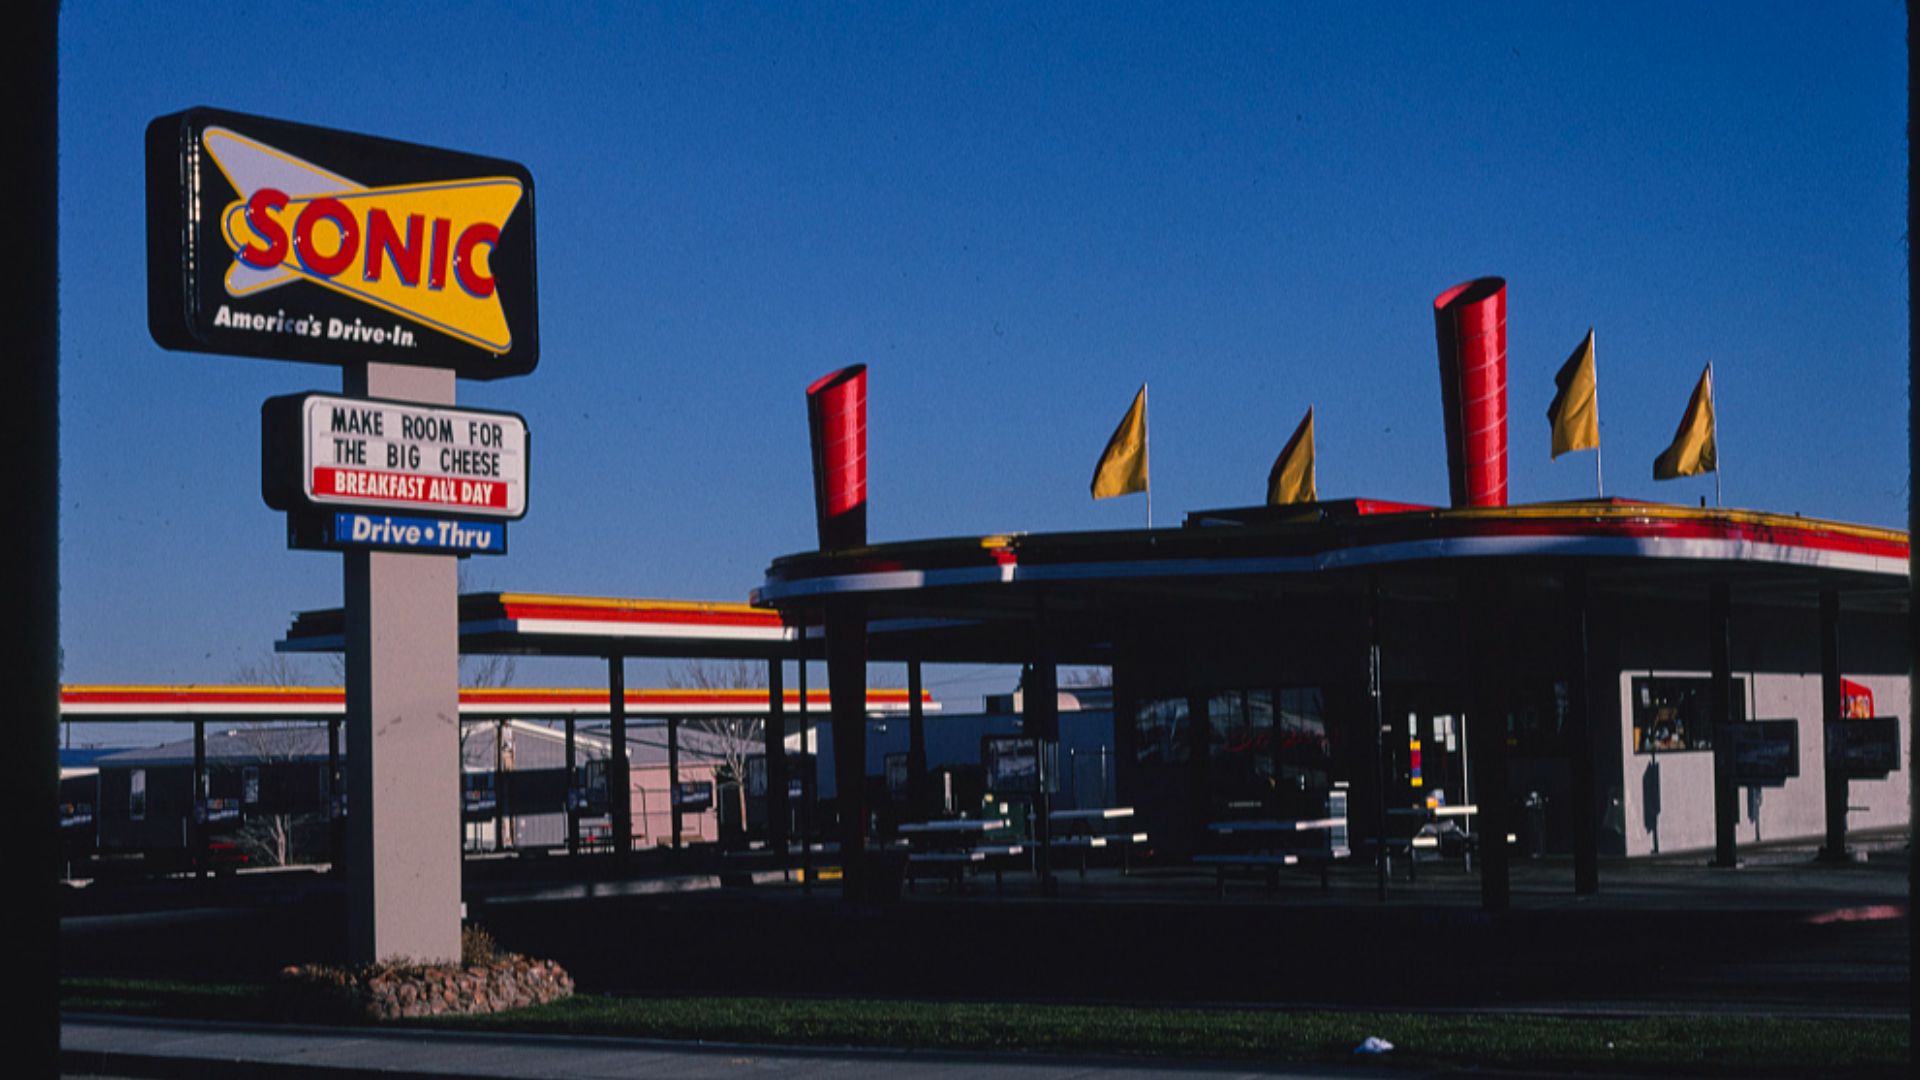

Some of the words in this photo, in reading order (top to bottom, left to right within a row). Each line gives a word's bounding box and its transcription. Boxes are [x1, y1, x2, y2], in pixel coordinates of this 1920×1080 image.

[235, 188, 500, 298] SONIC
[214, 305, 322, 338] America's
[331, 407, 384, 436] MAKE
[402, 415, 454, 444] ROOM
[468, 421, 503, 448] FOR
[333, 438, 367, 465] THE
[387, 443, 420, 470] BIG
[440, 448, 500, 477] CHEESE
[334, 470, 425, 500] BREAKFAST
[429, 480, 457, 505] ALL
[461, 483, 493, 505] DAY
